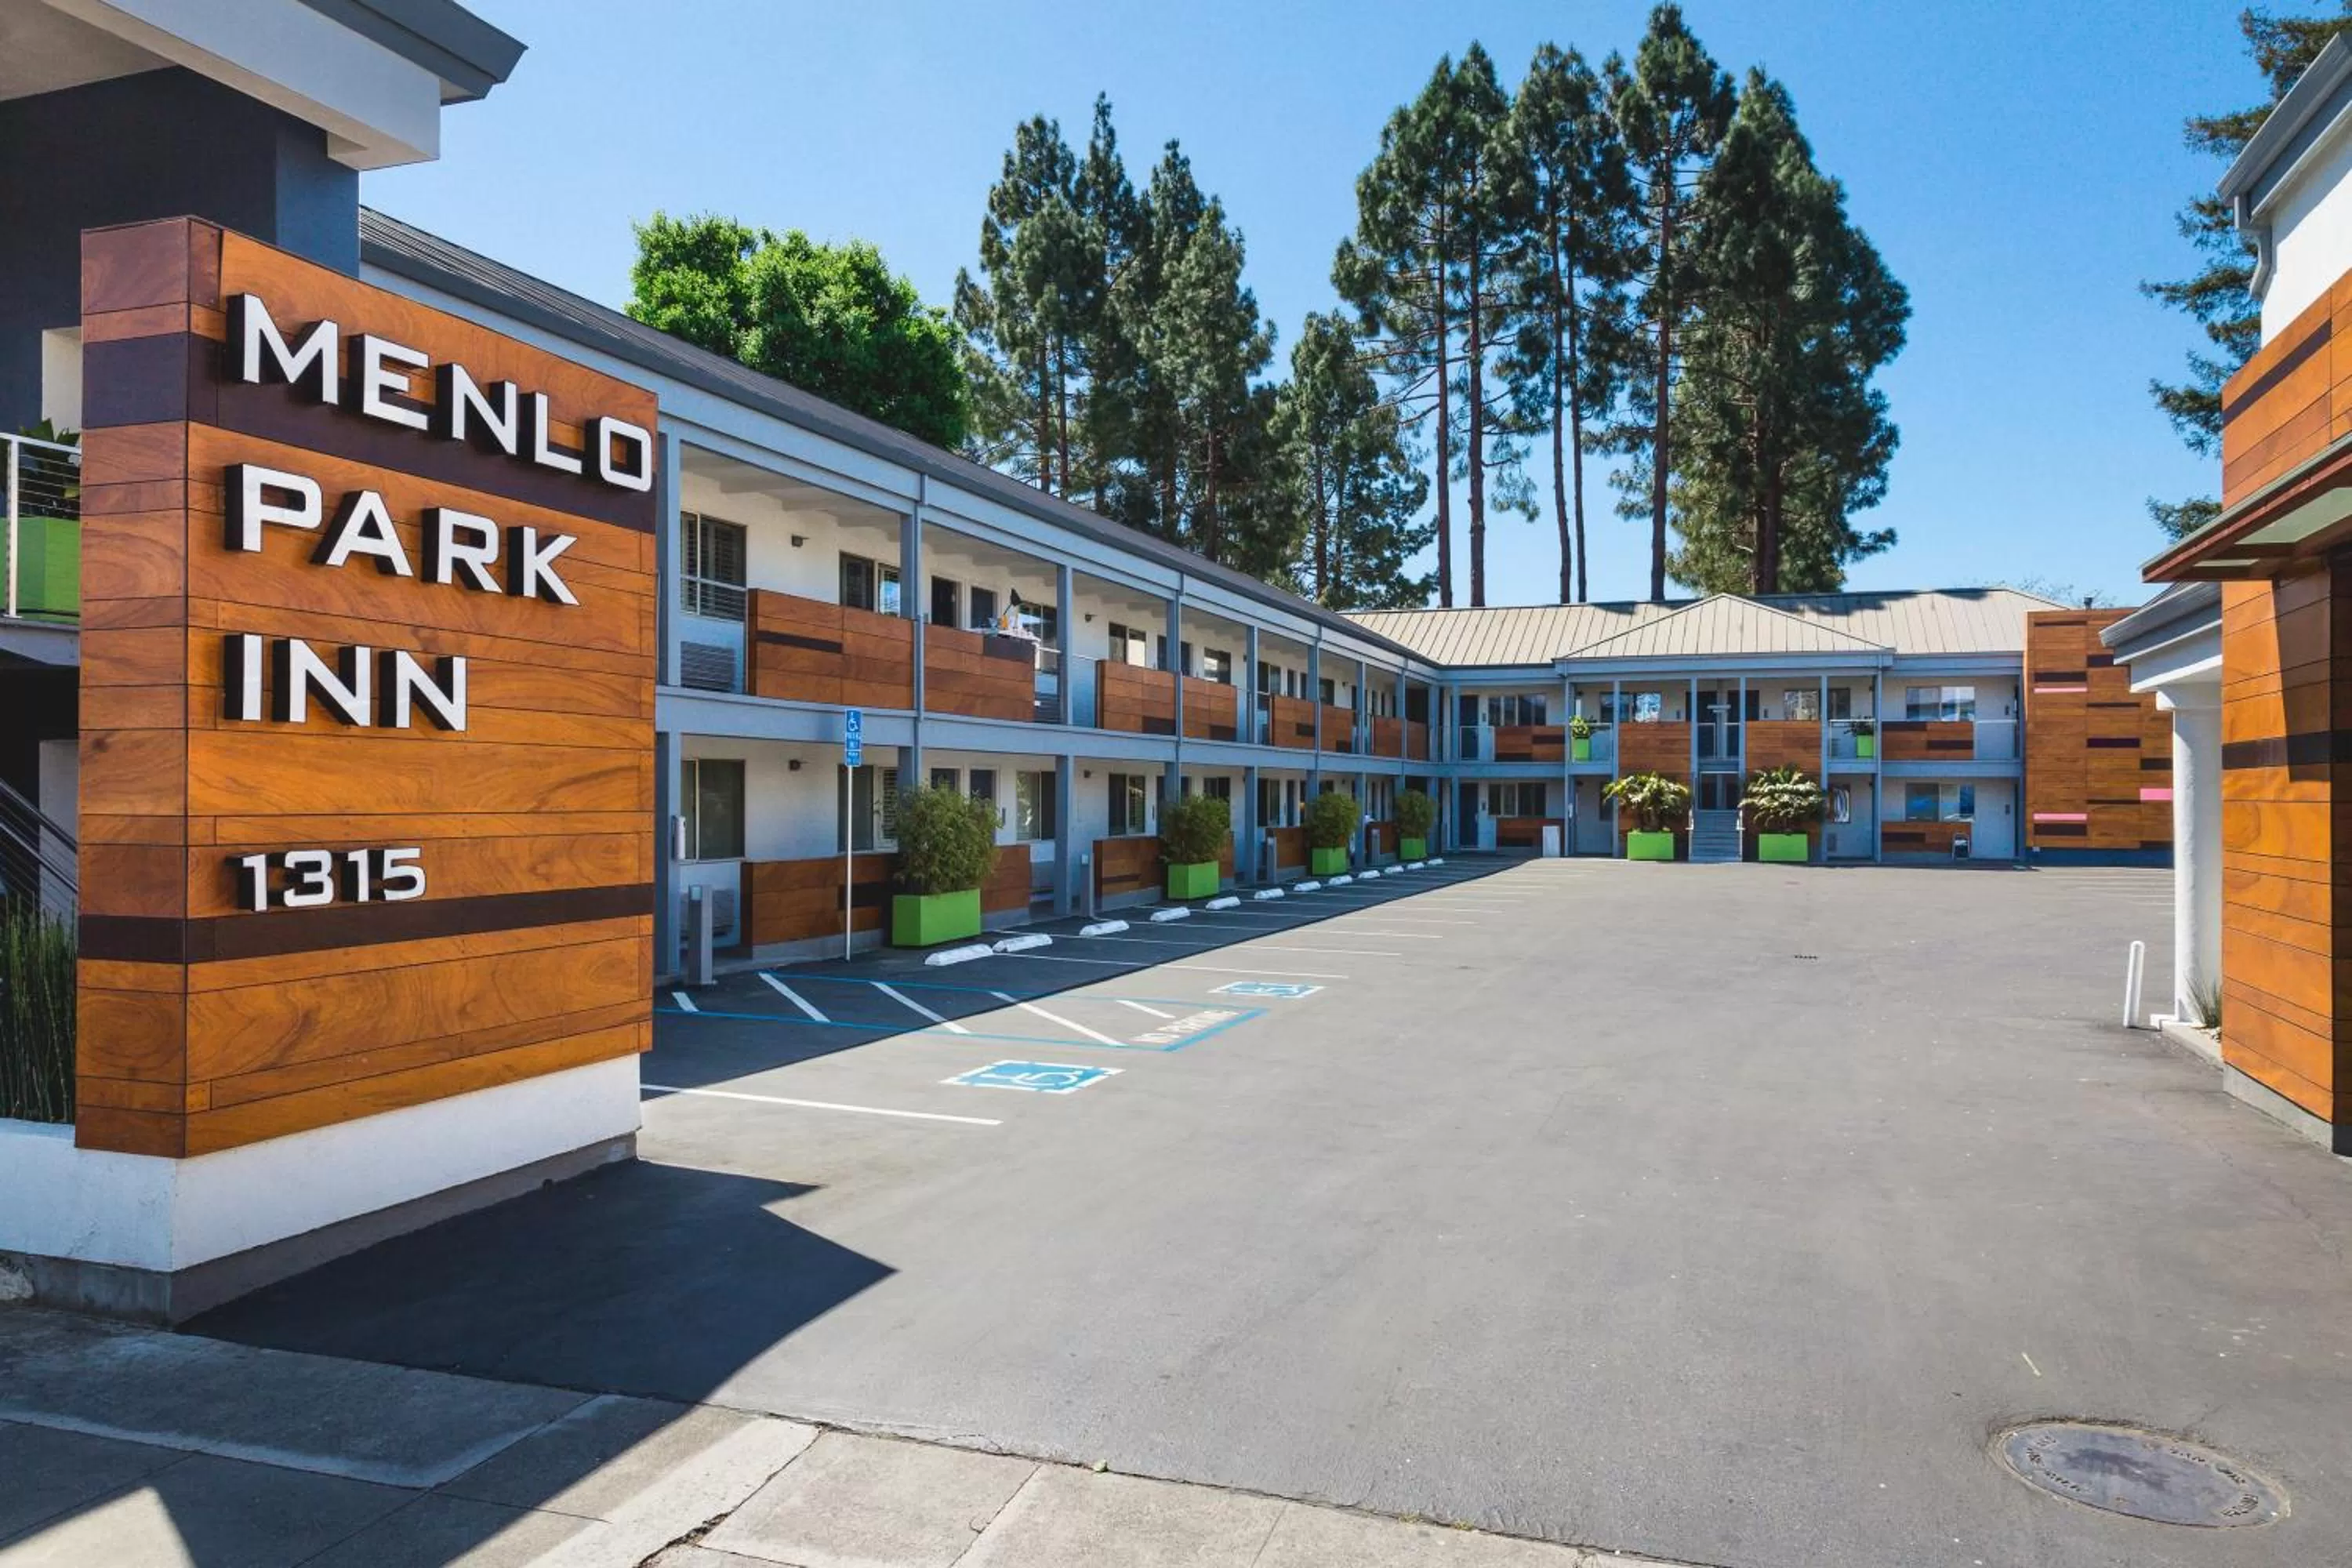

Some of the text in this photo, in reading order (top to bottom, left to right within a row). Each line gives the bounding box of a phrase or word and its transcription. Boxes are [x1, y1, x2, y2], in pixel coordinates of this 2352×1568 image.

[241, 292, 653, 494] MENLO
[241, 463, 580, 608] PARK
[241, 633, 468, 732] INN
[241, 847, 427, 912] 1315
